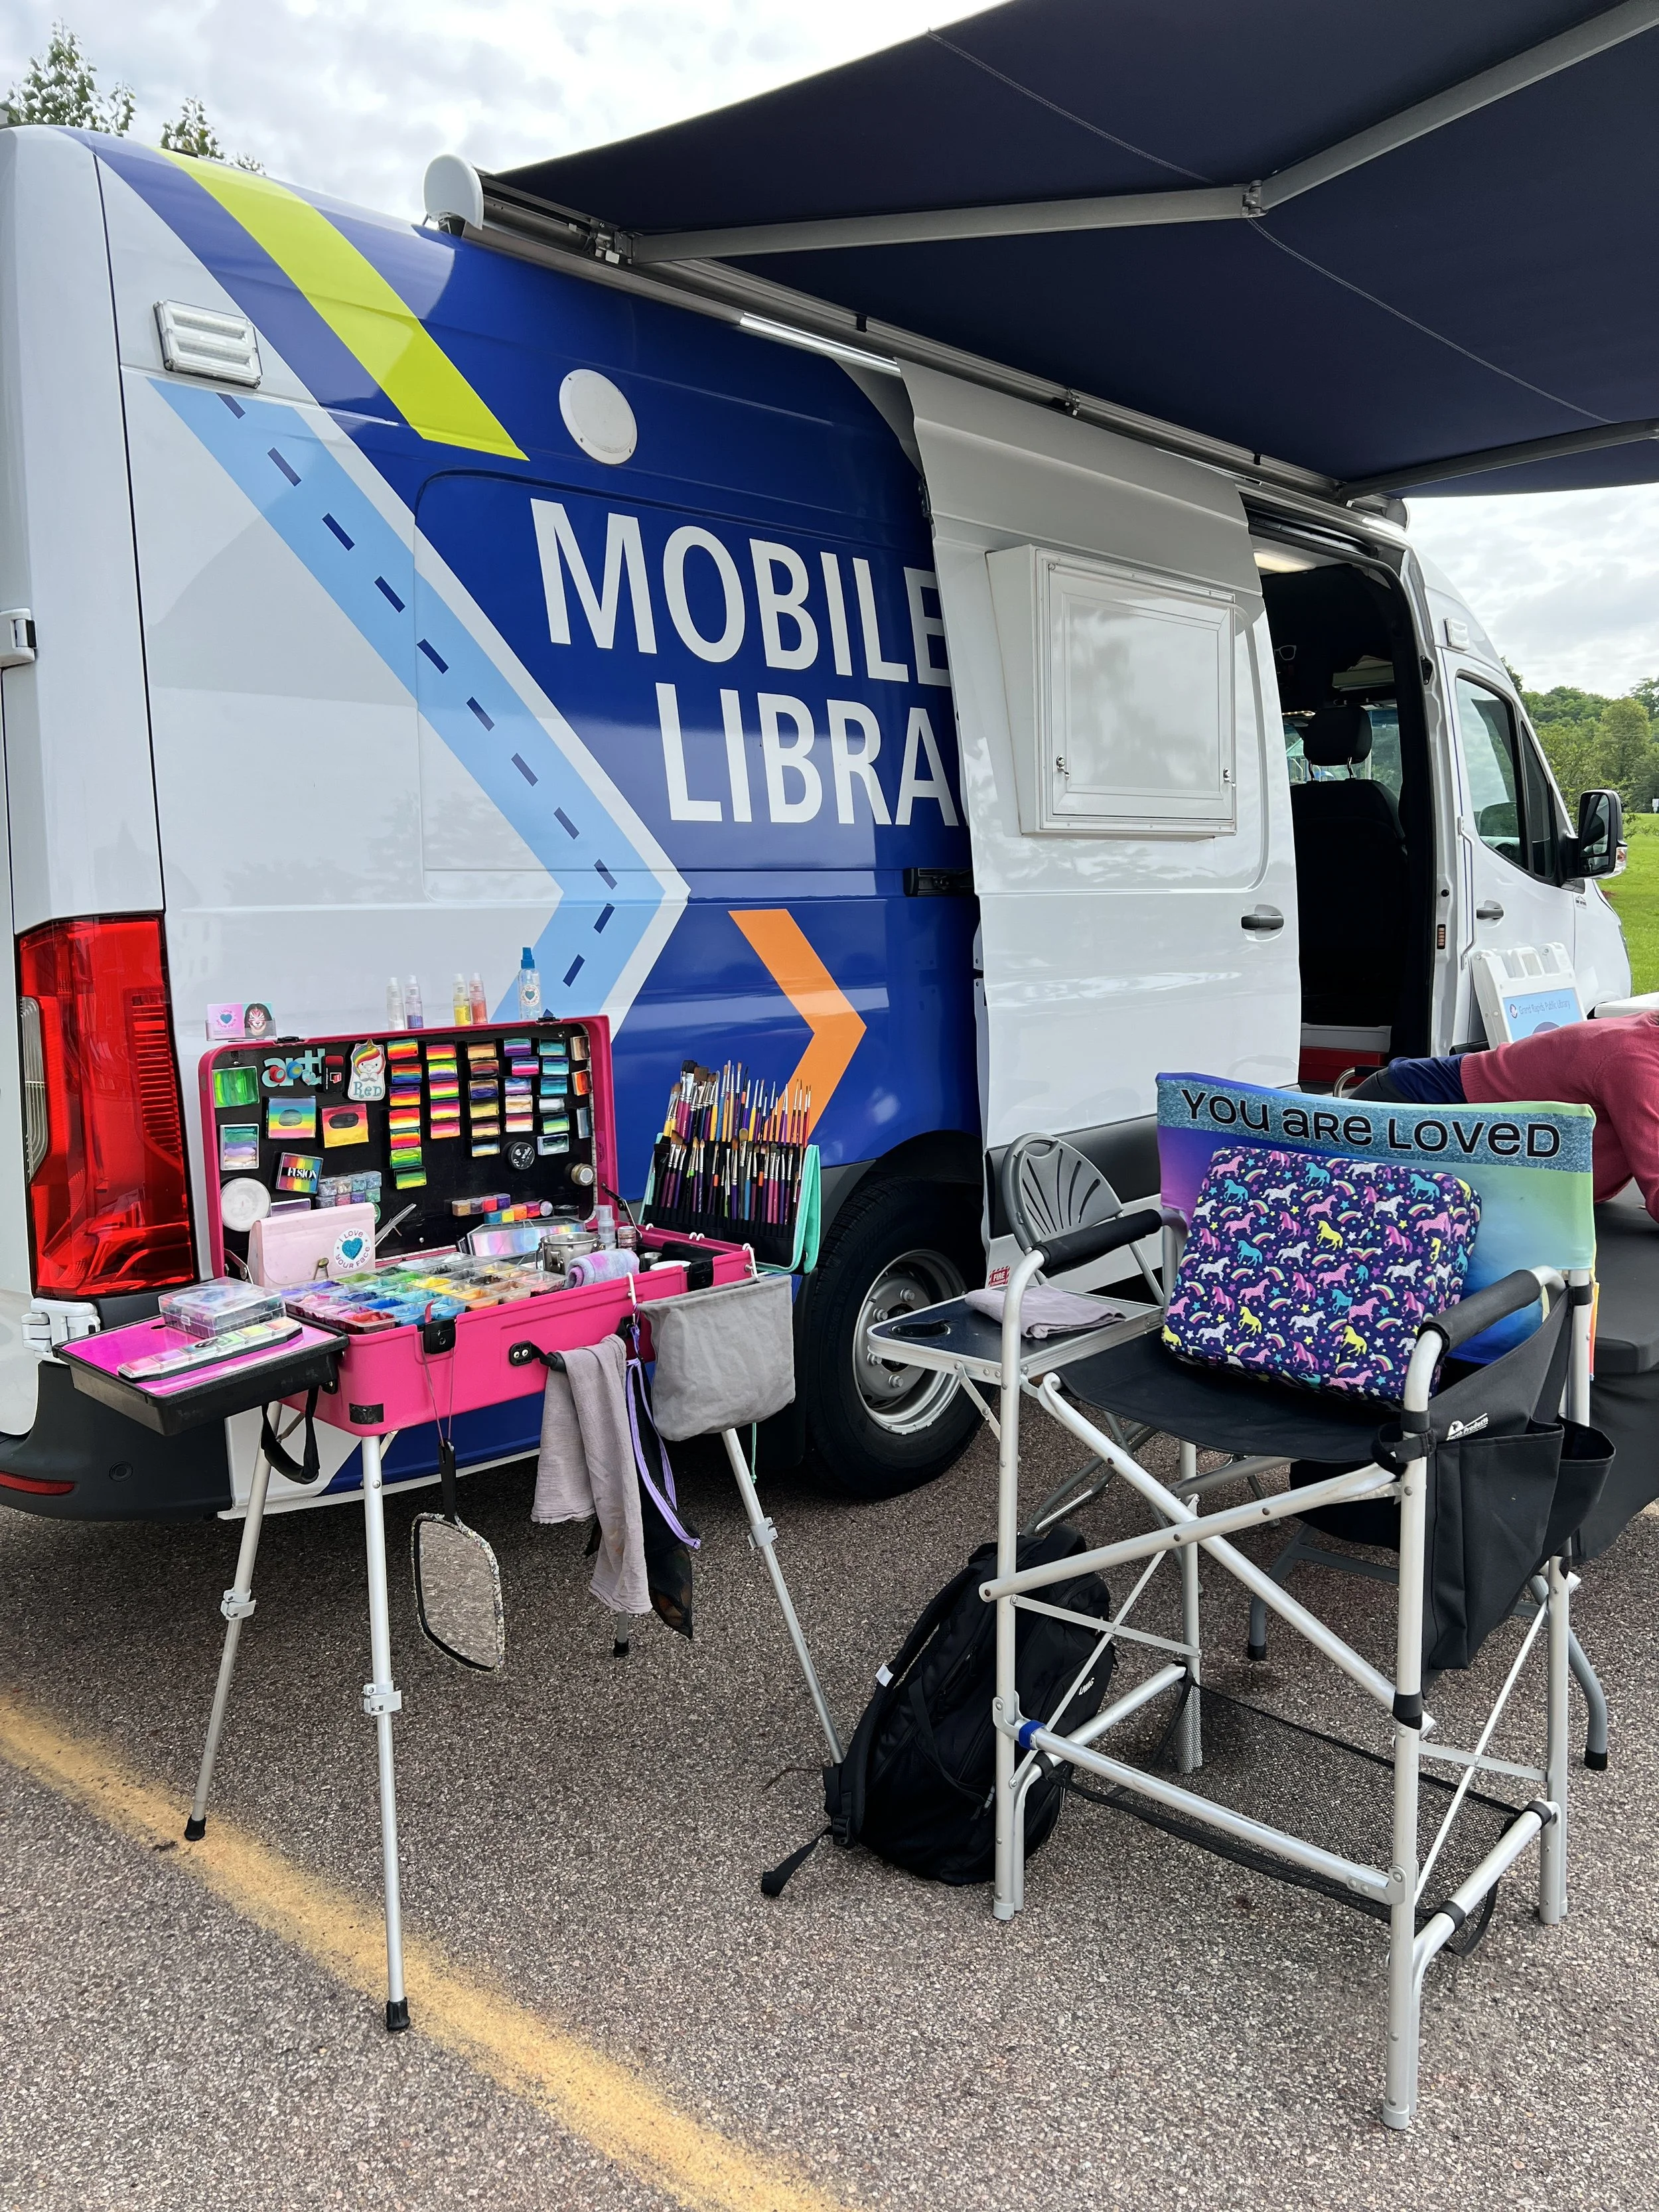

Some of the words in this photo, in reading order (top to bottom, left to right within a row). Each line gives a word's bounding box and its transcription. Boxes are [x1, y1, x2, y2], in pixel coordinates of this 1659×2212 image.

[531, 498, 952, 687] MOBILE
[655, 682, 960, 826] LIBRA
[353, 1080, 382, 1099] Ren
[287, 1167, 317, 1179] FUSION
[993, 1272, 1005, 1282] FIRE
